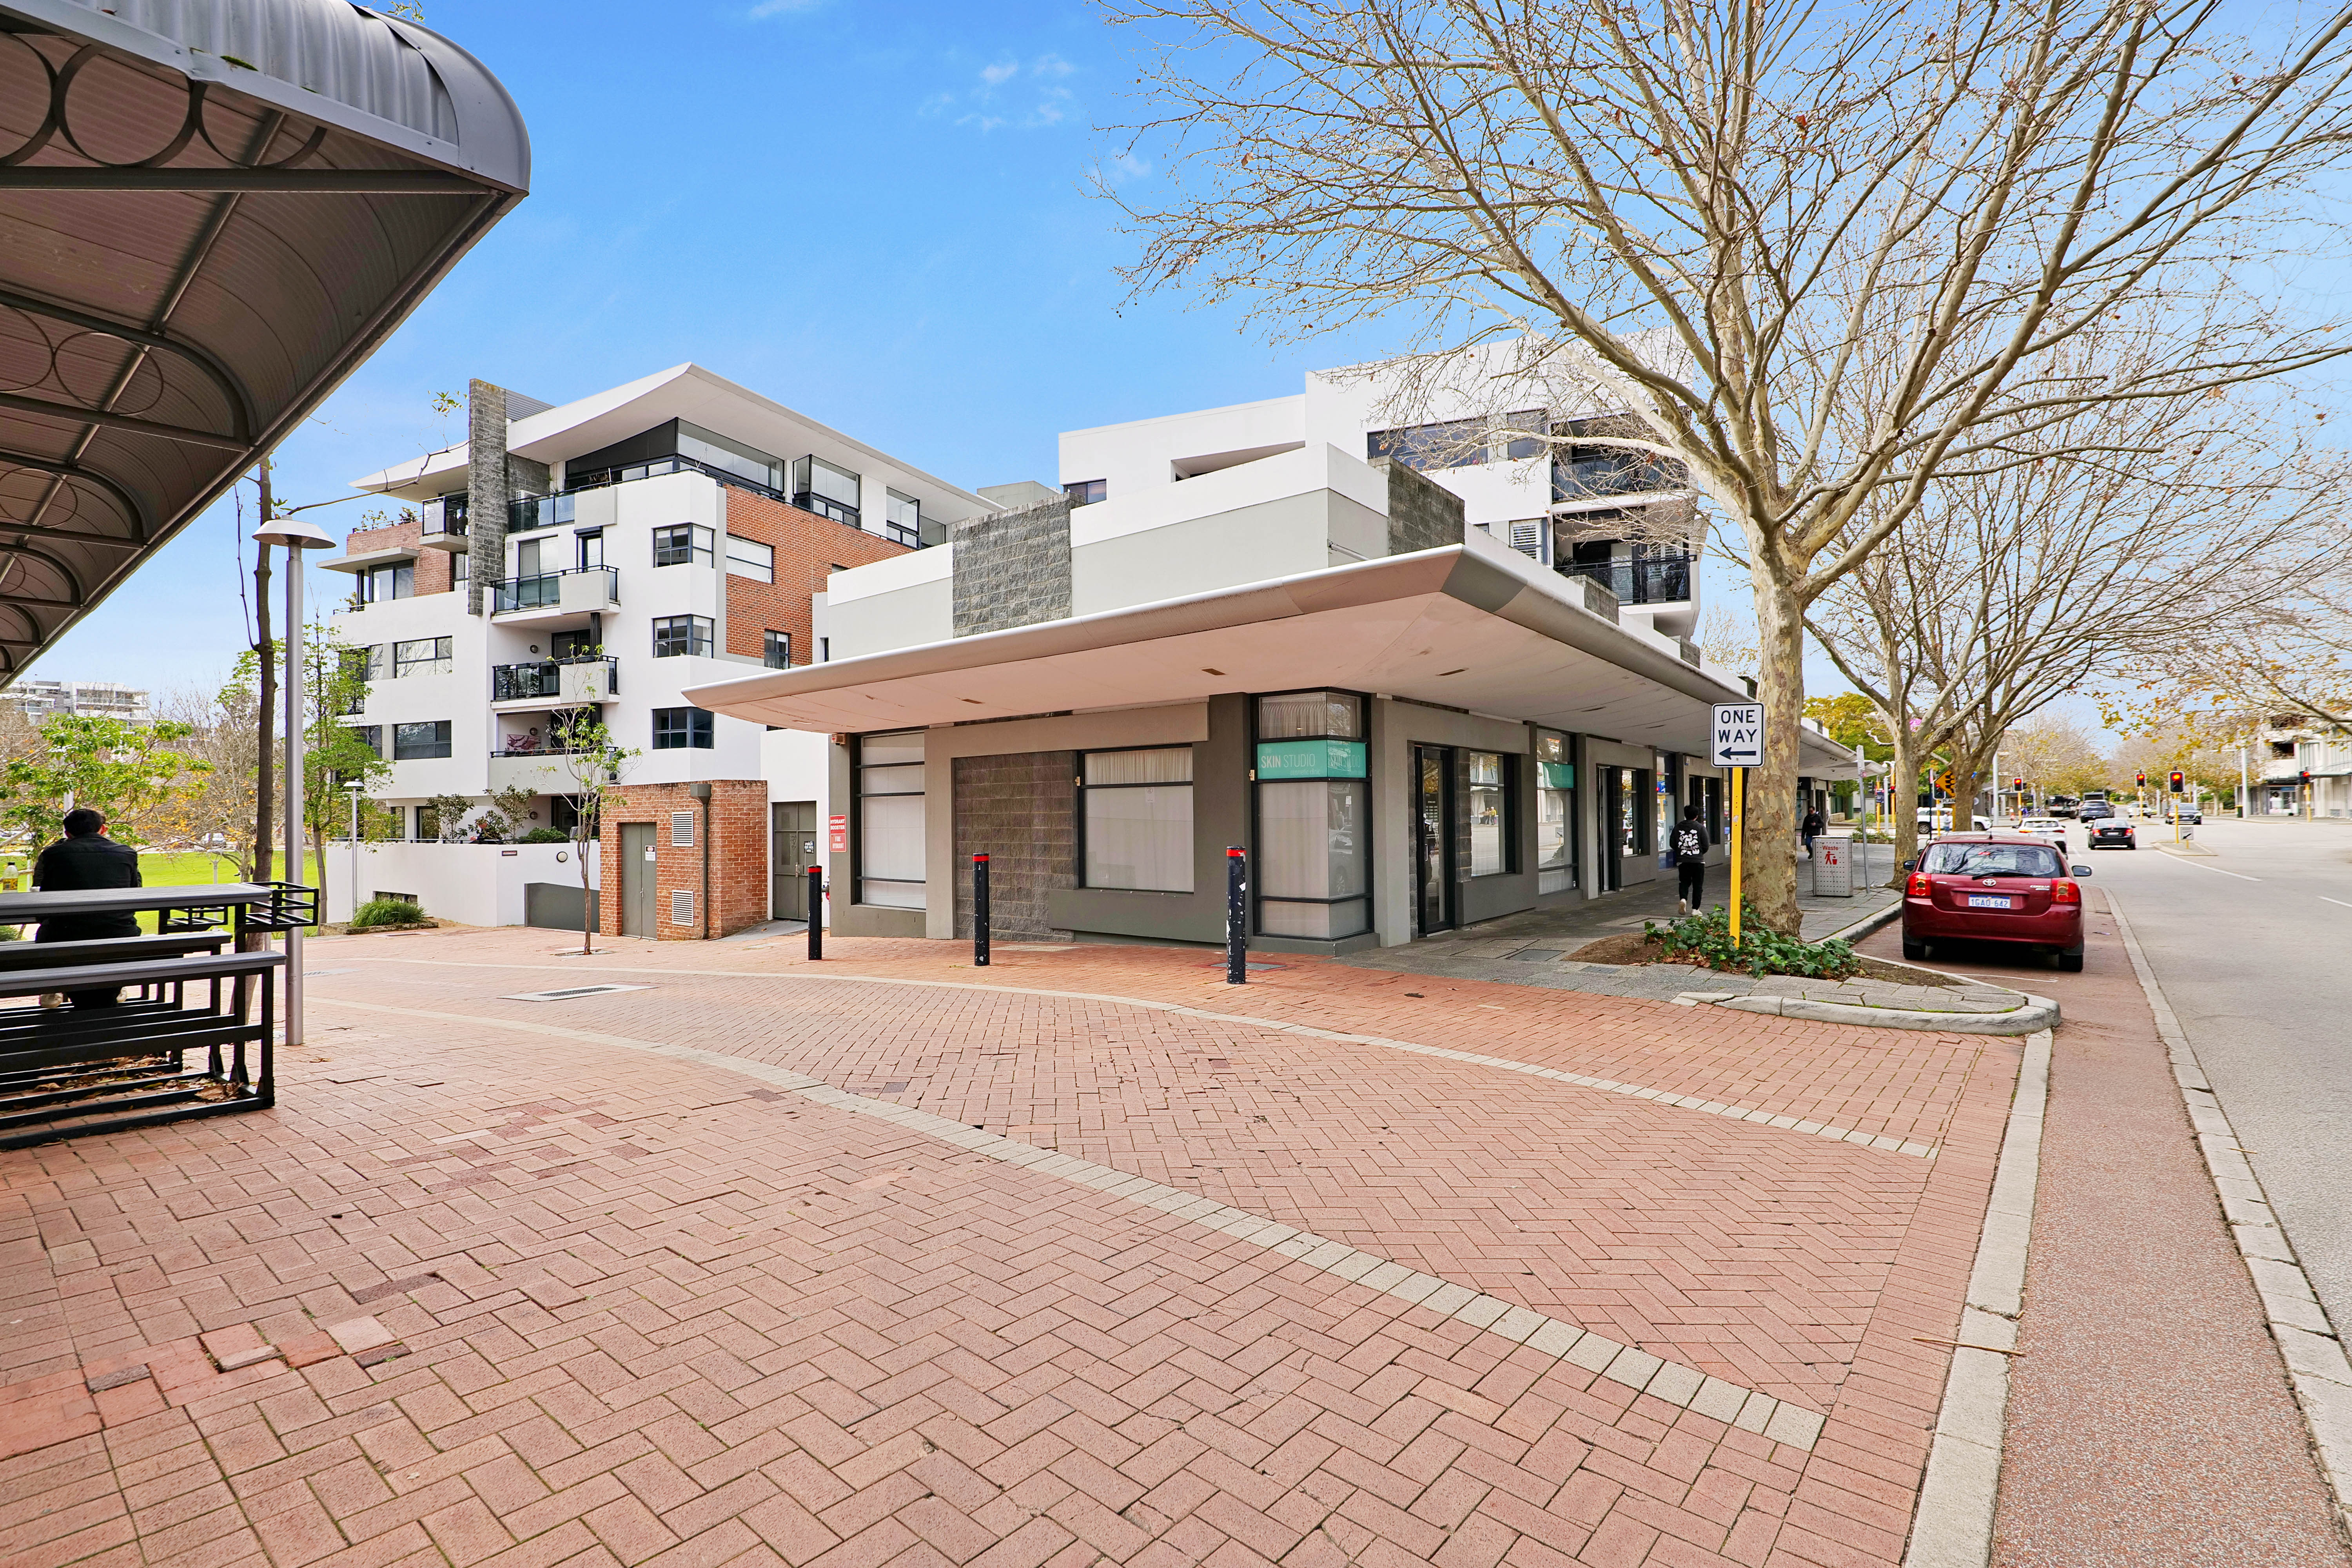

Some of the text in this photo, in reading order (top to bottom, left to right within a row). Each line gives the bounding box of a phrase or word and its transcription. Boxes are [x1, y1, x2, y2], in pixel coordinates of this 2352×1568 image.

[1721, 710, 1755, 724] ONE
[1718, 729, 1758, 742] WAY
[1261, 754, 1315, 768] SKIN STUDIO
[1330, 754, 1342, 766] SKIN
